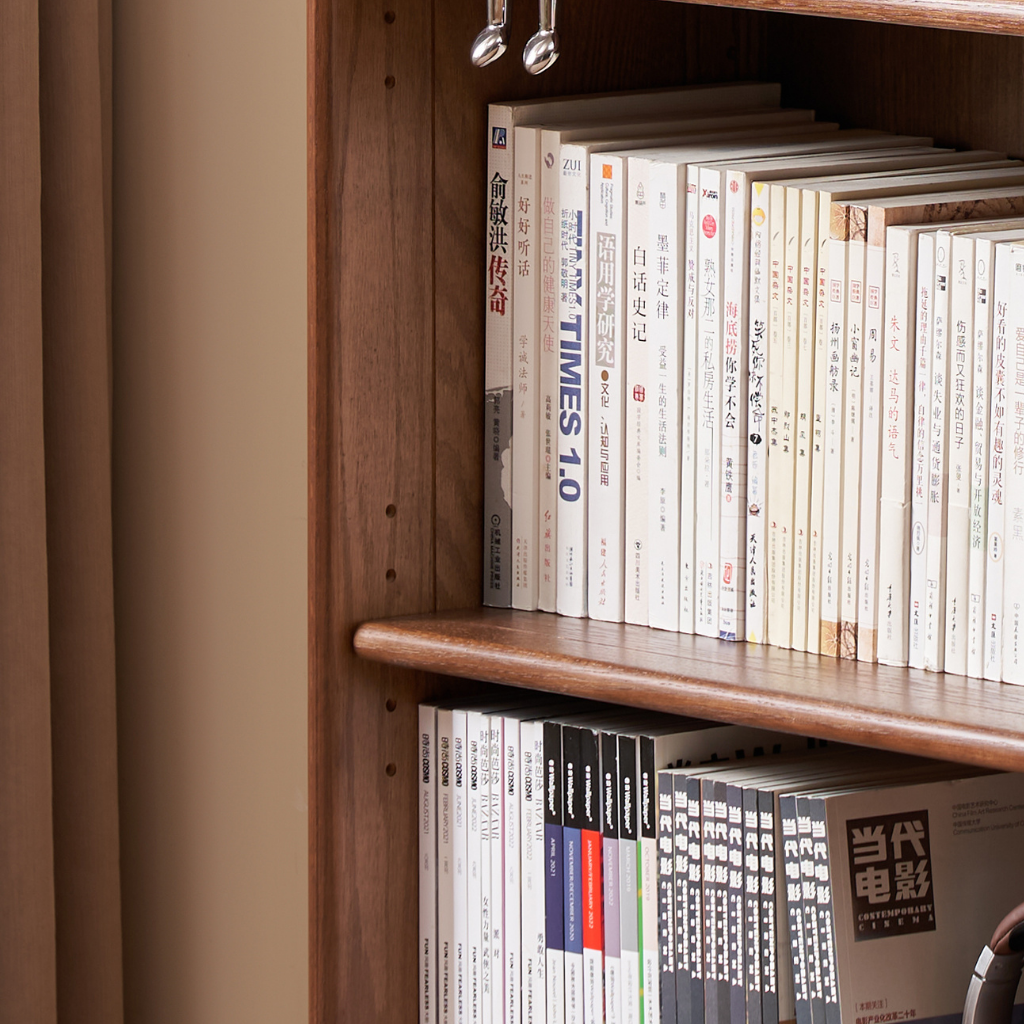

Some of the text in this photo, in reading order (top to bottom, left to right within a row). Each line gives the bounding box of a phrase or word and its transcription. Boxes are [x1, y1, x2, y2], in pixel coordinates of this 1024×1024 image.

[563, 158, 582, 171] ZUI
[489, 171, 509, 316] 俞敏洪传奇
[517, 196, 531, 278] 好好听话
[542, 196, 556, 354] 做自己的健康天使
[656, 233, 670, 320] 墨菲定律
[597, 233, 615, 364] 语用学研究
[632, 246, 647, 342] 白话史记
[688, 259, 696, 320] 赞成与反对
[772, 260, 780, 302] 中国杂文
[786, 265, 794, 306] 中国杂文
[802, 266, 810, 308] 中国杂文
[818, 267, 826, 309] 中国杂文
[725, 301, 739, 430] 海底捞你学不会
[829, 321, 840, 392] 扬州画舫录
[849, 323, 860, 378] 小窗幽记
[868, 328, 877, 364] 周易
[889, 314, 900, 352] 朱文
[934, 316, 943, 361] 萨缪尔森
[976, 328, 984, 374] 萨缪尔森
[558, 314, 582, 502] TIMES 1.0
[658, 345, 668, 458] 受益一生的生活法则
[887, 368, 899, 460] 达马的语气
[954, 320, 967, 450] 伤感而又狂欢的日子
[991, 301, 1008, 506] 好看的皮囊不如有趣的灵魂
[930, 371, 943, 504] 谈失业与通货膨胀
[971, 385, 984, 550] 谈金融、贸易与开放经济
[749, 532, 758, 609] 天津人民出版社
[659, 793, 673, 876] 当代电影
[675, 791, 688, 873] 当代电影
[688, 799, 701, 882] 当代电影
[703, 799, 715, 883] 当代电影
[714, 801, 728, 883] 当代电影
[728, 805, 742, 889] 当代电影
[744, 810, 759, 894] 当代电影
[760, 811, 775, 895] 当代电影
[851, 819, 926, 866] 当代
[952, 810, 967, 818] China
[985, 806, 1008, 814] Research
[952, 825, 990, 836] Communication
[990, 823, 1014, 832] University
[782, 818, 801, 901] 当代电影
[797, 816, 816, 899] 当代电影
[811, 820, 831, 904] 当代电影
[855, 858, 930, 905] 电影
[858, 904, 933, 922] CONTEMPORARY
